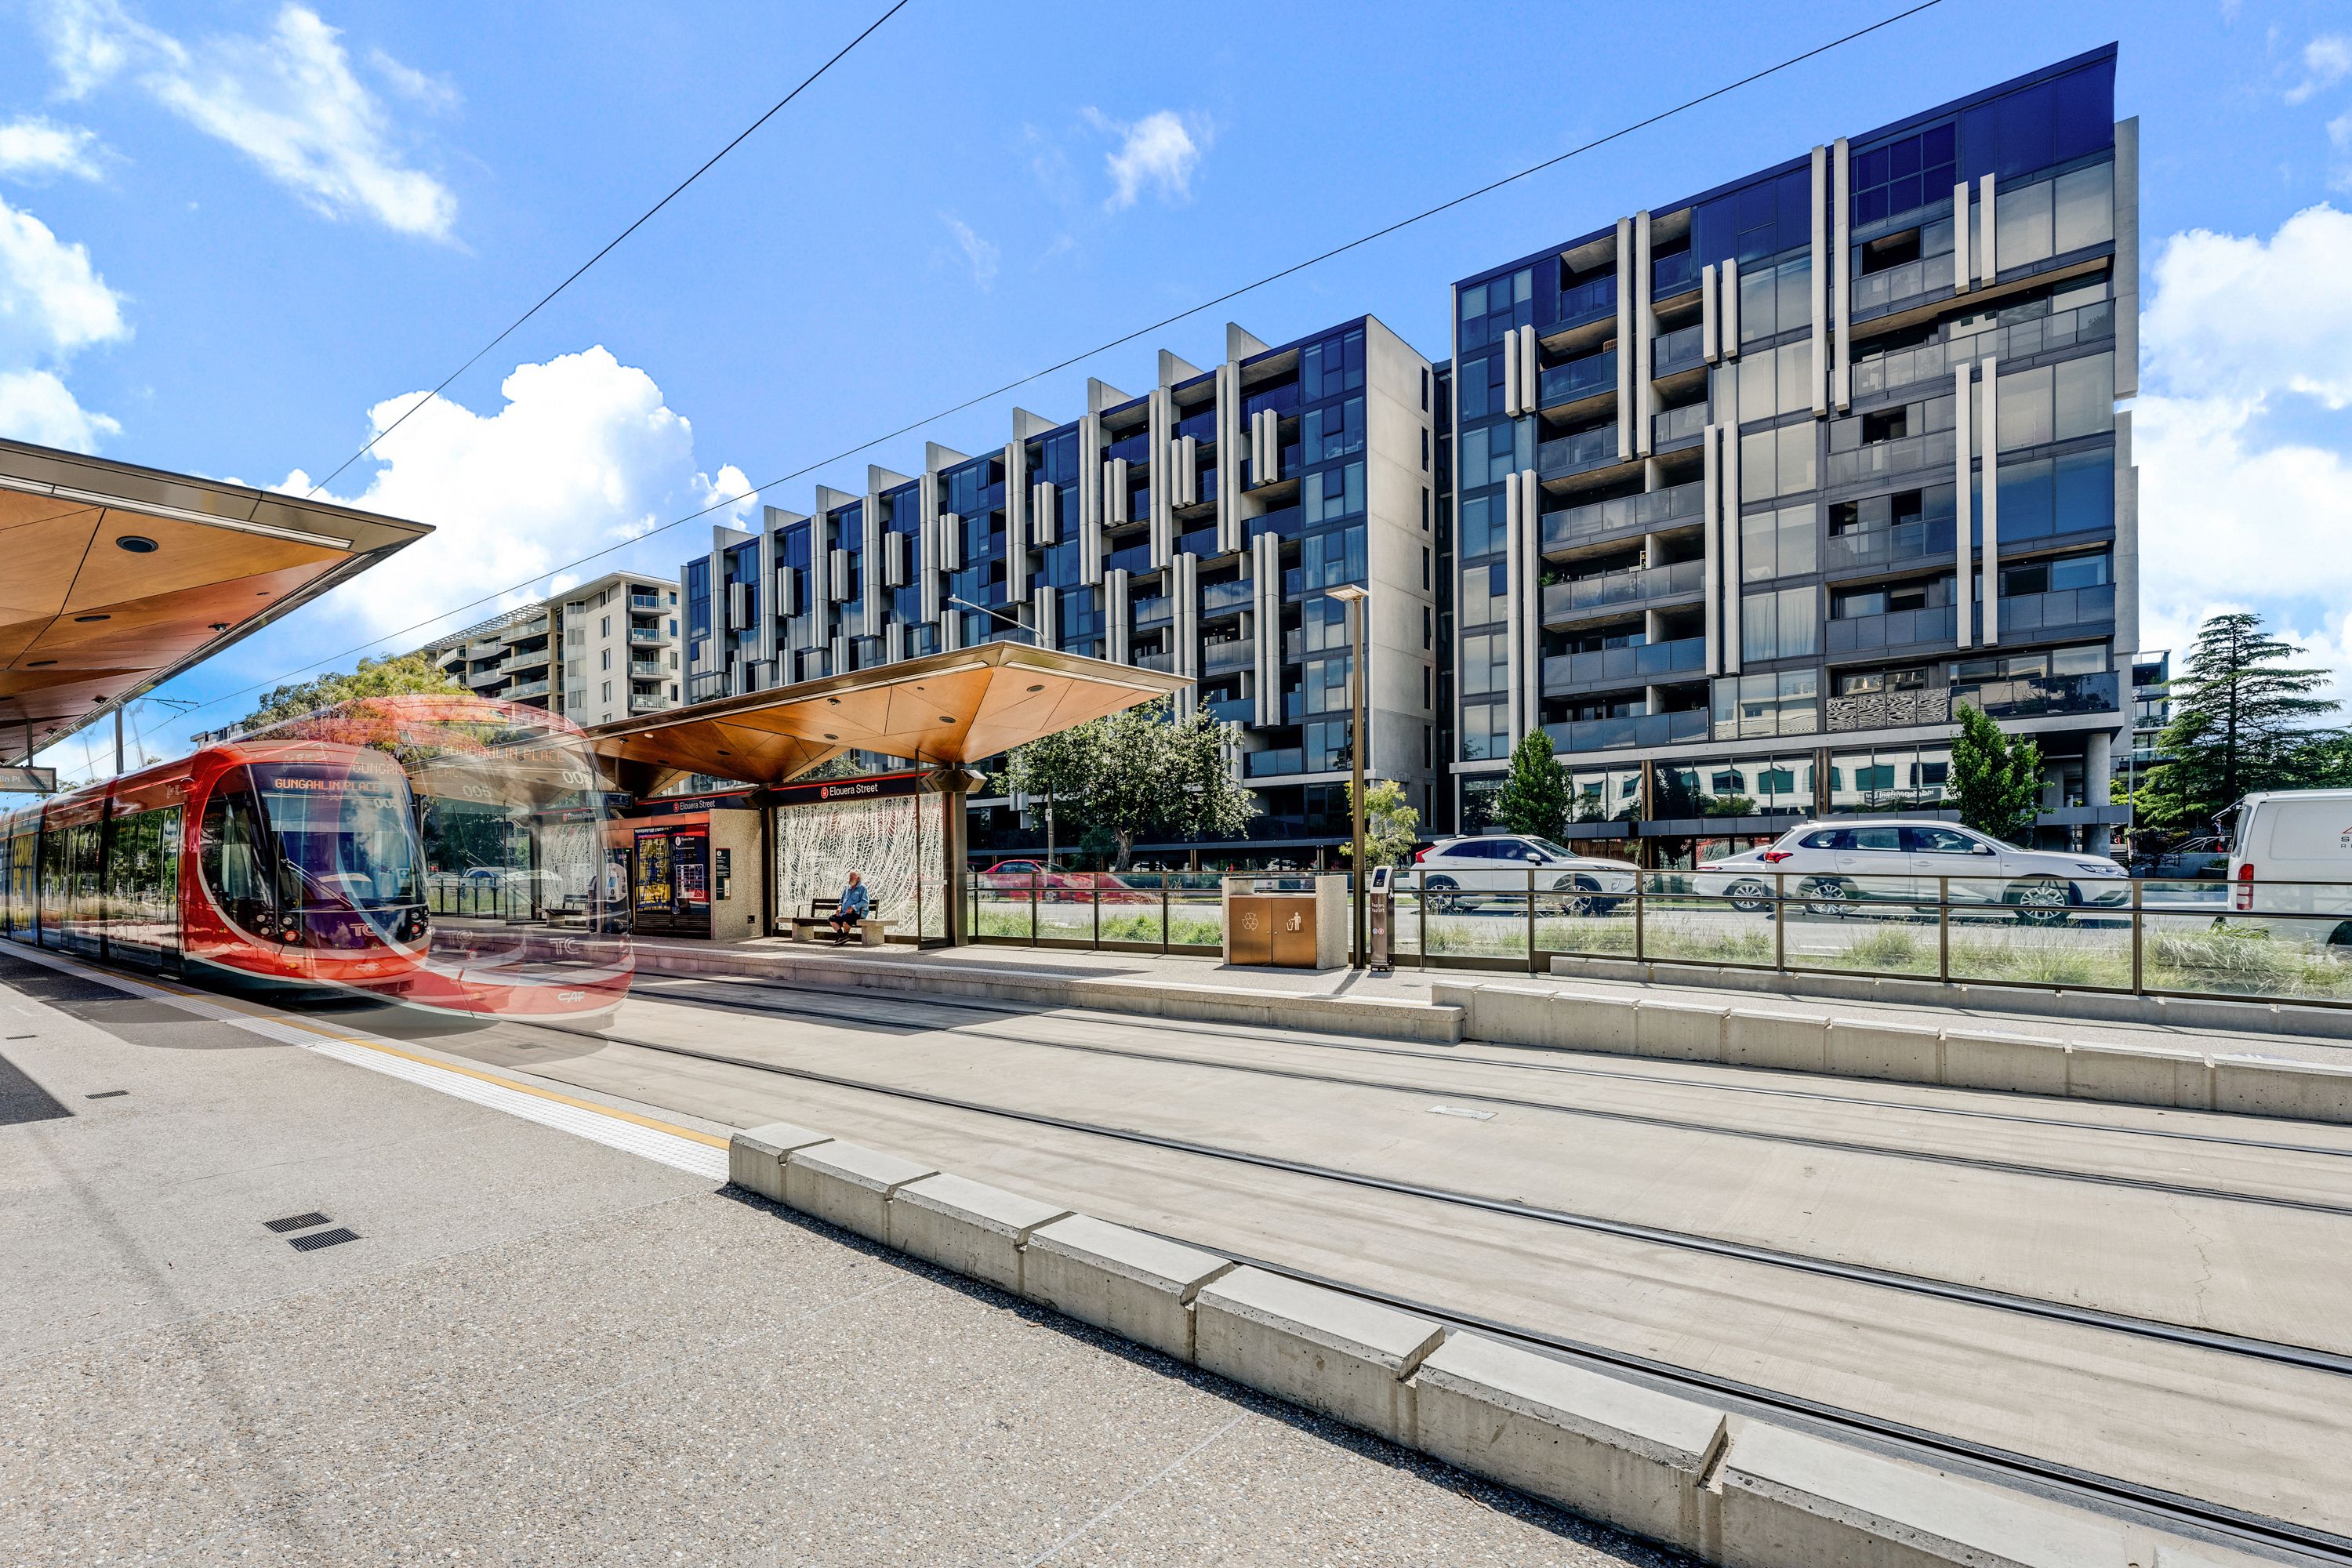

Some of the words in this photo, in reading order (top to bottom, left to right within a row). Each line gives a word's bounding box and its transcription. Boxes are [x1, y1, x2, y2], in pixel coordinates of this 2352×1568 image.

[524, 747, 565, 763] PLACE
[275, 779, 340, 791] GUNGAHLIN
[343, 781, 379, 792] PLACE
[829, 786, 855, 797] Elouera
[855, 783, 878, 794] Street
[680, 802, 699, 811] Elouera
[699, 800, 716, 808] Street
[549, 937, 579, 956] TC
[557, 991, 585, 1003] CAF
